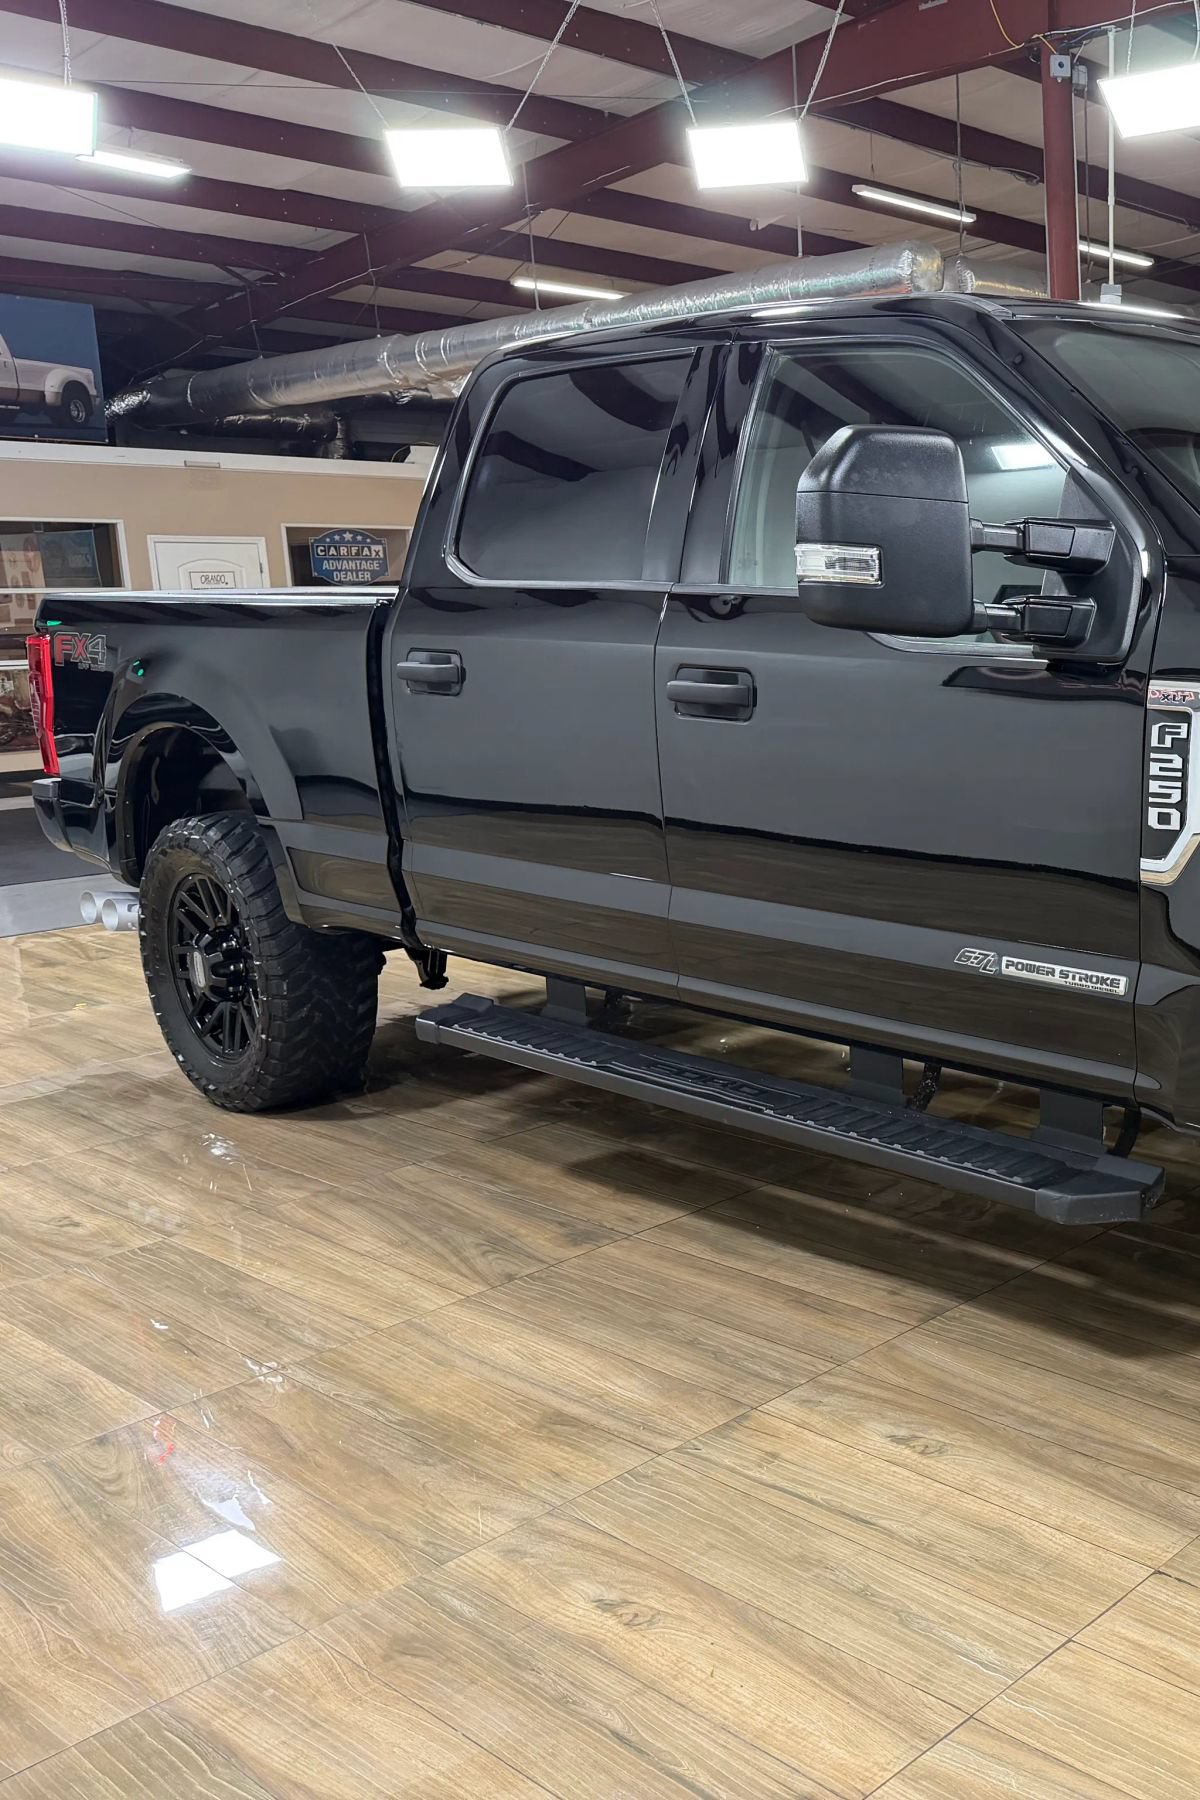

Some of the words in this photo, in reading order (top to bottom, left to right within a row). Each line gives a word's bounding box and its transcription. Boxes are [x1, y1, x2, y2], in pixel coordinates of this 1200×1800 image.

[317, 546, 382, 557] CARFAX
[323, 560, 380, 570] ADVANTAGE
[334, 571, 372, 581] DEALER
[54, 631, 107, 667] FX4
[1160, 693, 1189, 703] XLT
[1147, 722, 1188, 831] F250
[1004, 959, 1056, 978] POWER
[1058, 969, 1121, 989] STROKE
